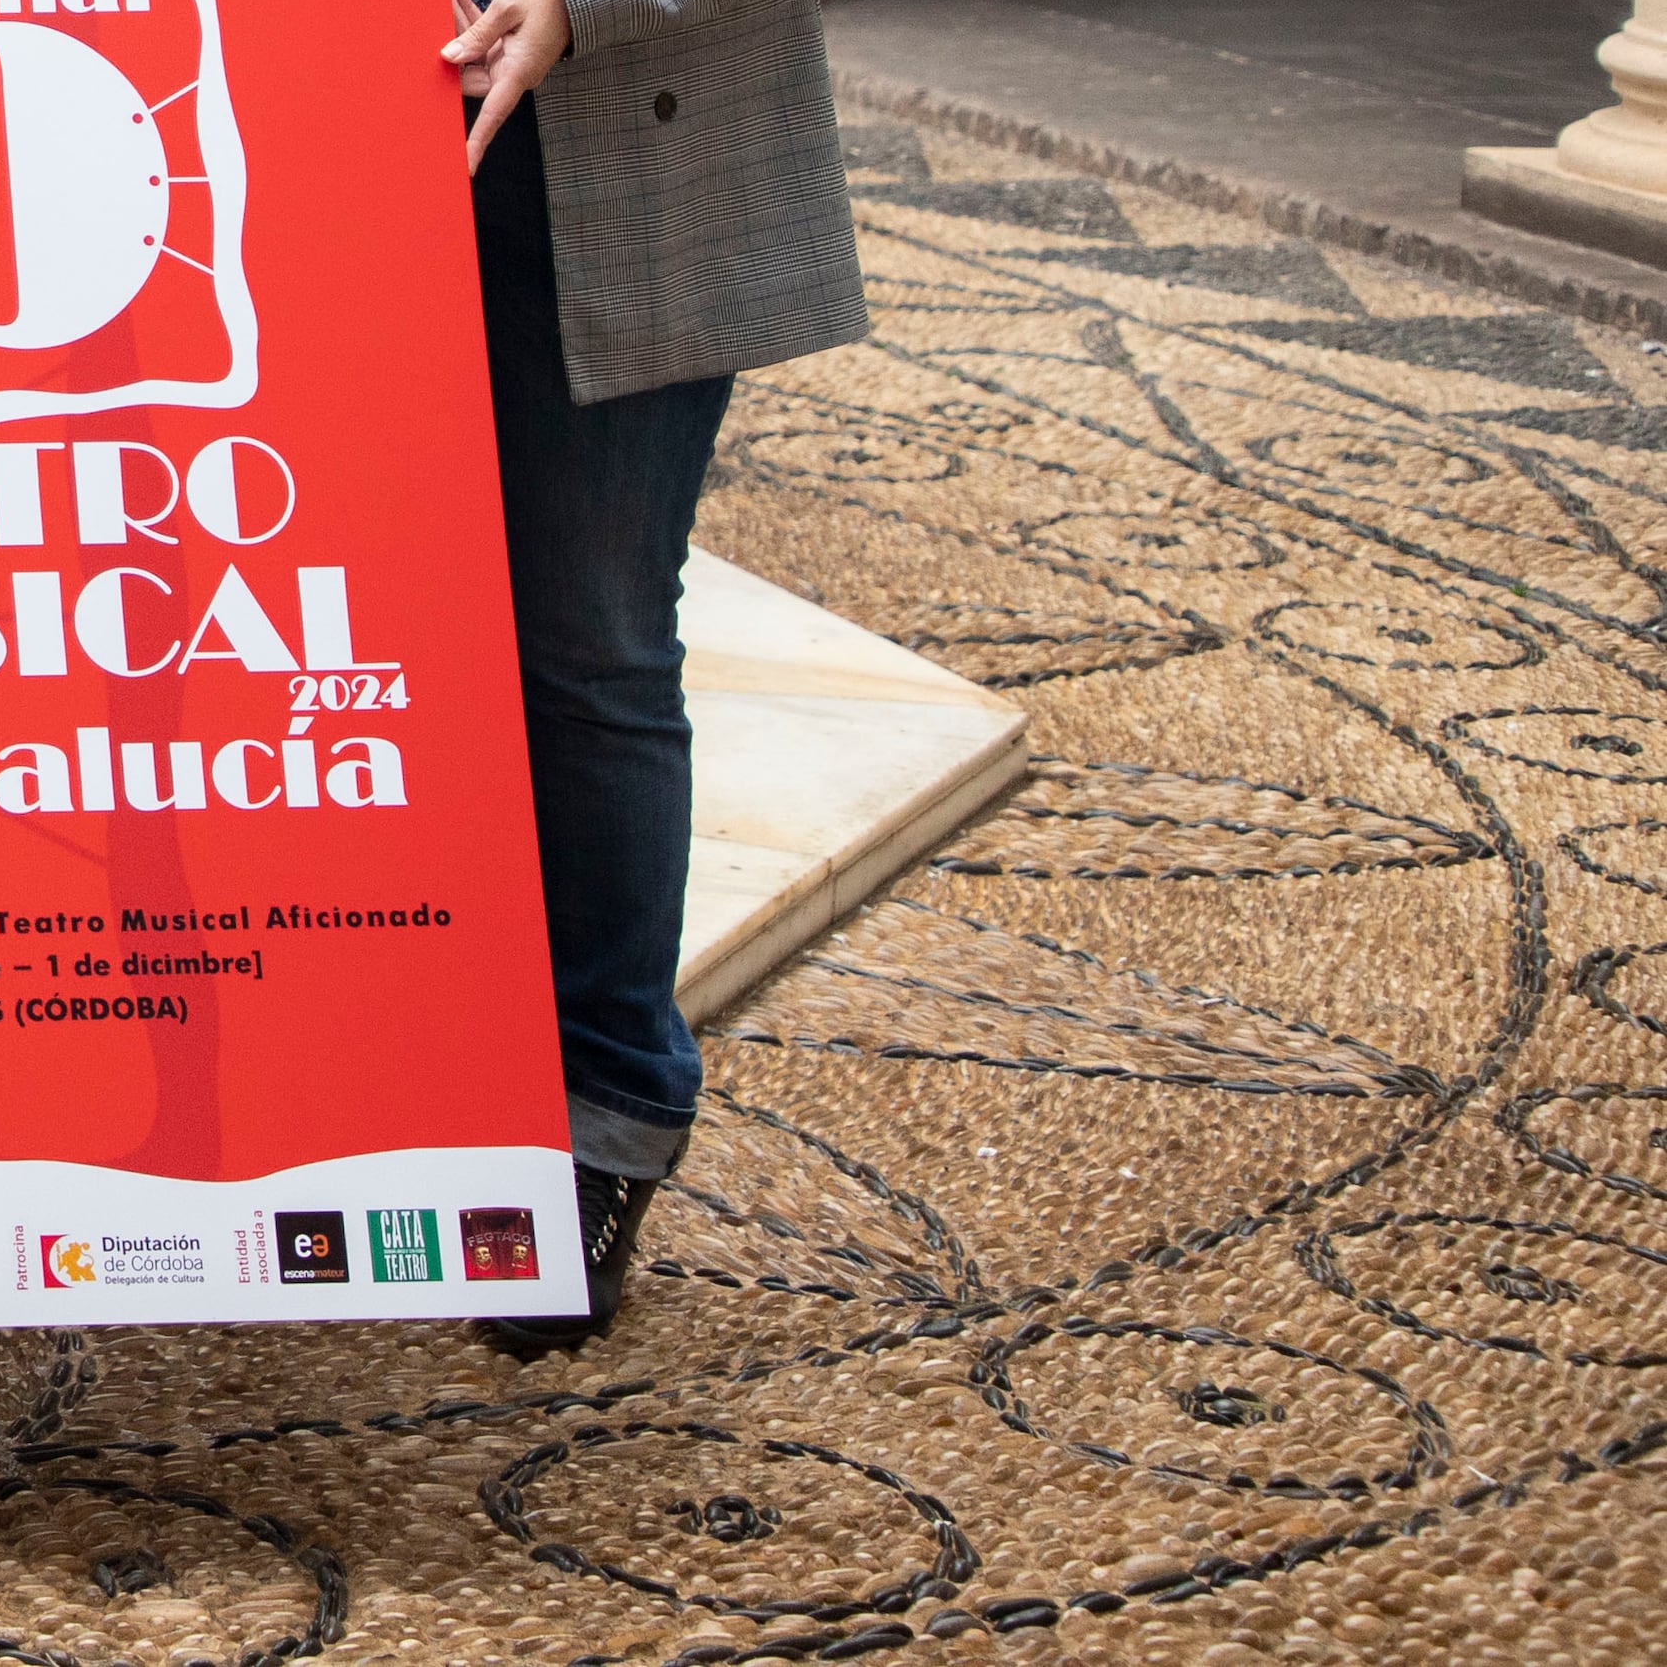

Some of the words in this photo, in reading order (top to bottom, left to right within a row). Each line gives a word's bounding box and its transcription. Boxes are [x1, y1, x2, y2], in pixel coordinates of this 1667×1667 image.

[288, 672, 411, 712] 2024
[121, 906, 250, 933] Musical
[266, 903, 452, 930] Aficionado
[46, 954, 59, 978] 1
[74, 952, 110, 977] de
[122, 949, 264, 981] dicimbre]
[15, 993, 188, 1027] (CÓRDOBA)
[102, 1234, 201, 1255] Diputación
[379, 1210, 427, 1249] CATA
[466, 1231, 533, 1247] FEGTACO
[17, 1224, 29, 1291] Patrocina
[104, 1255, 125, 1273] de
[130, 1254, 204, 1273] Córdoba
[235, 1229, 251, 1284] Entidad
[254, 1223, 269, 1284] asociada
[383, 1254, 429, 1281] TEATRO
[105, 1274, 155, 1287] Delegación
[172, 1274, 205, 1284] Cultura
